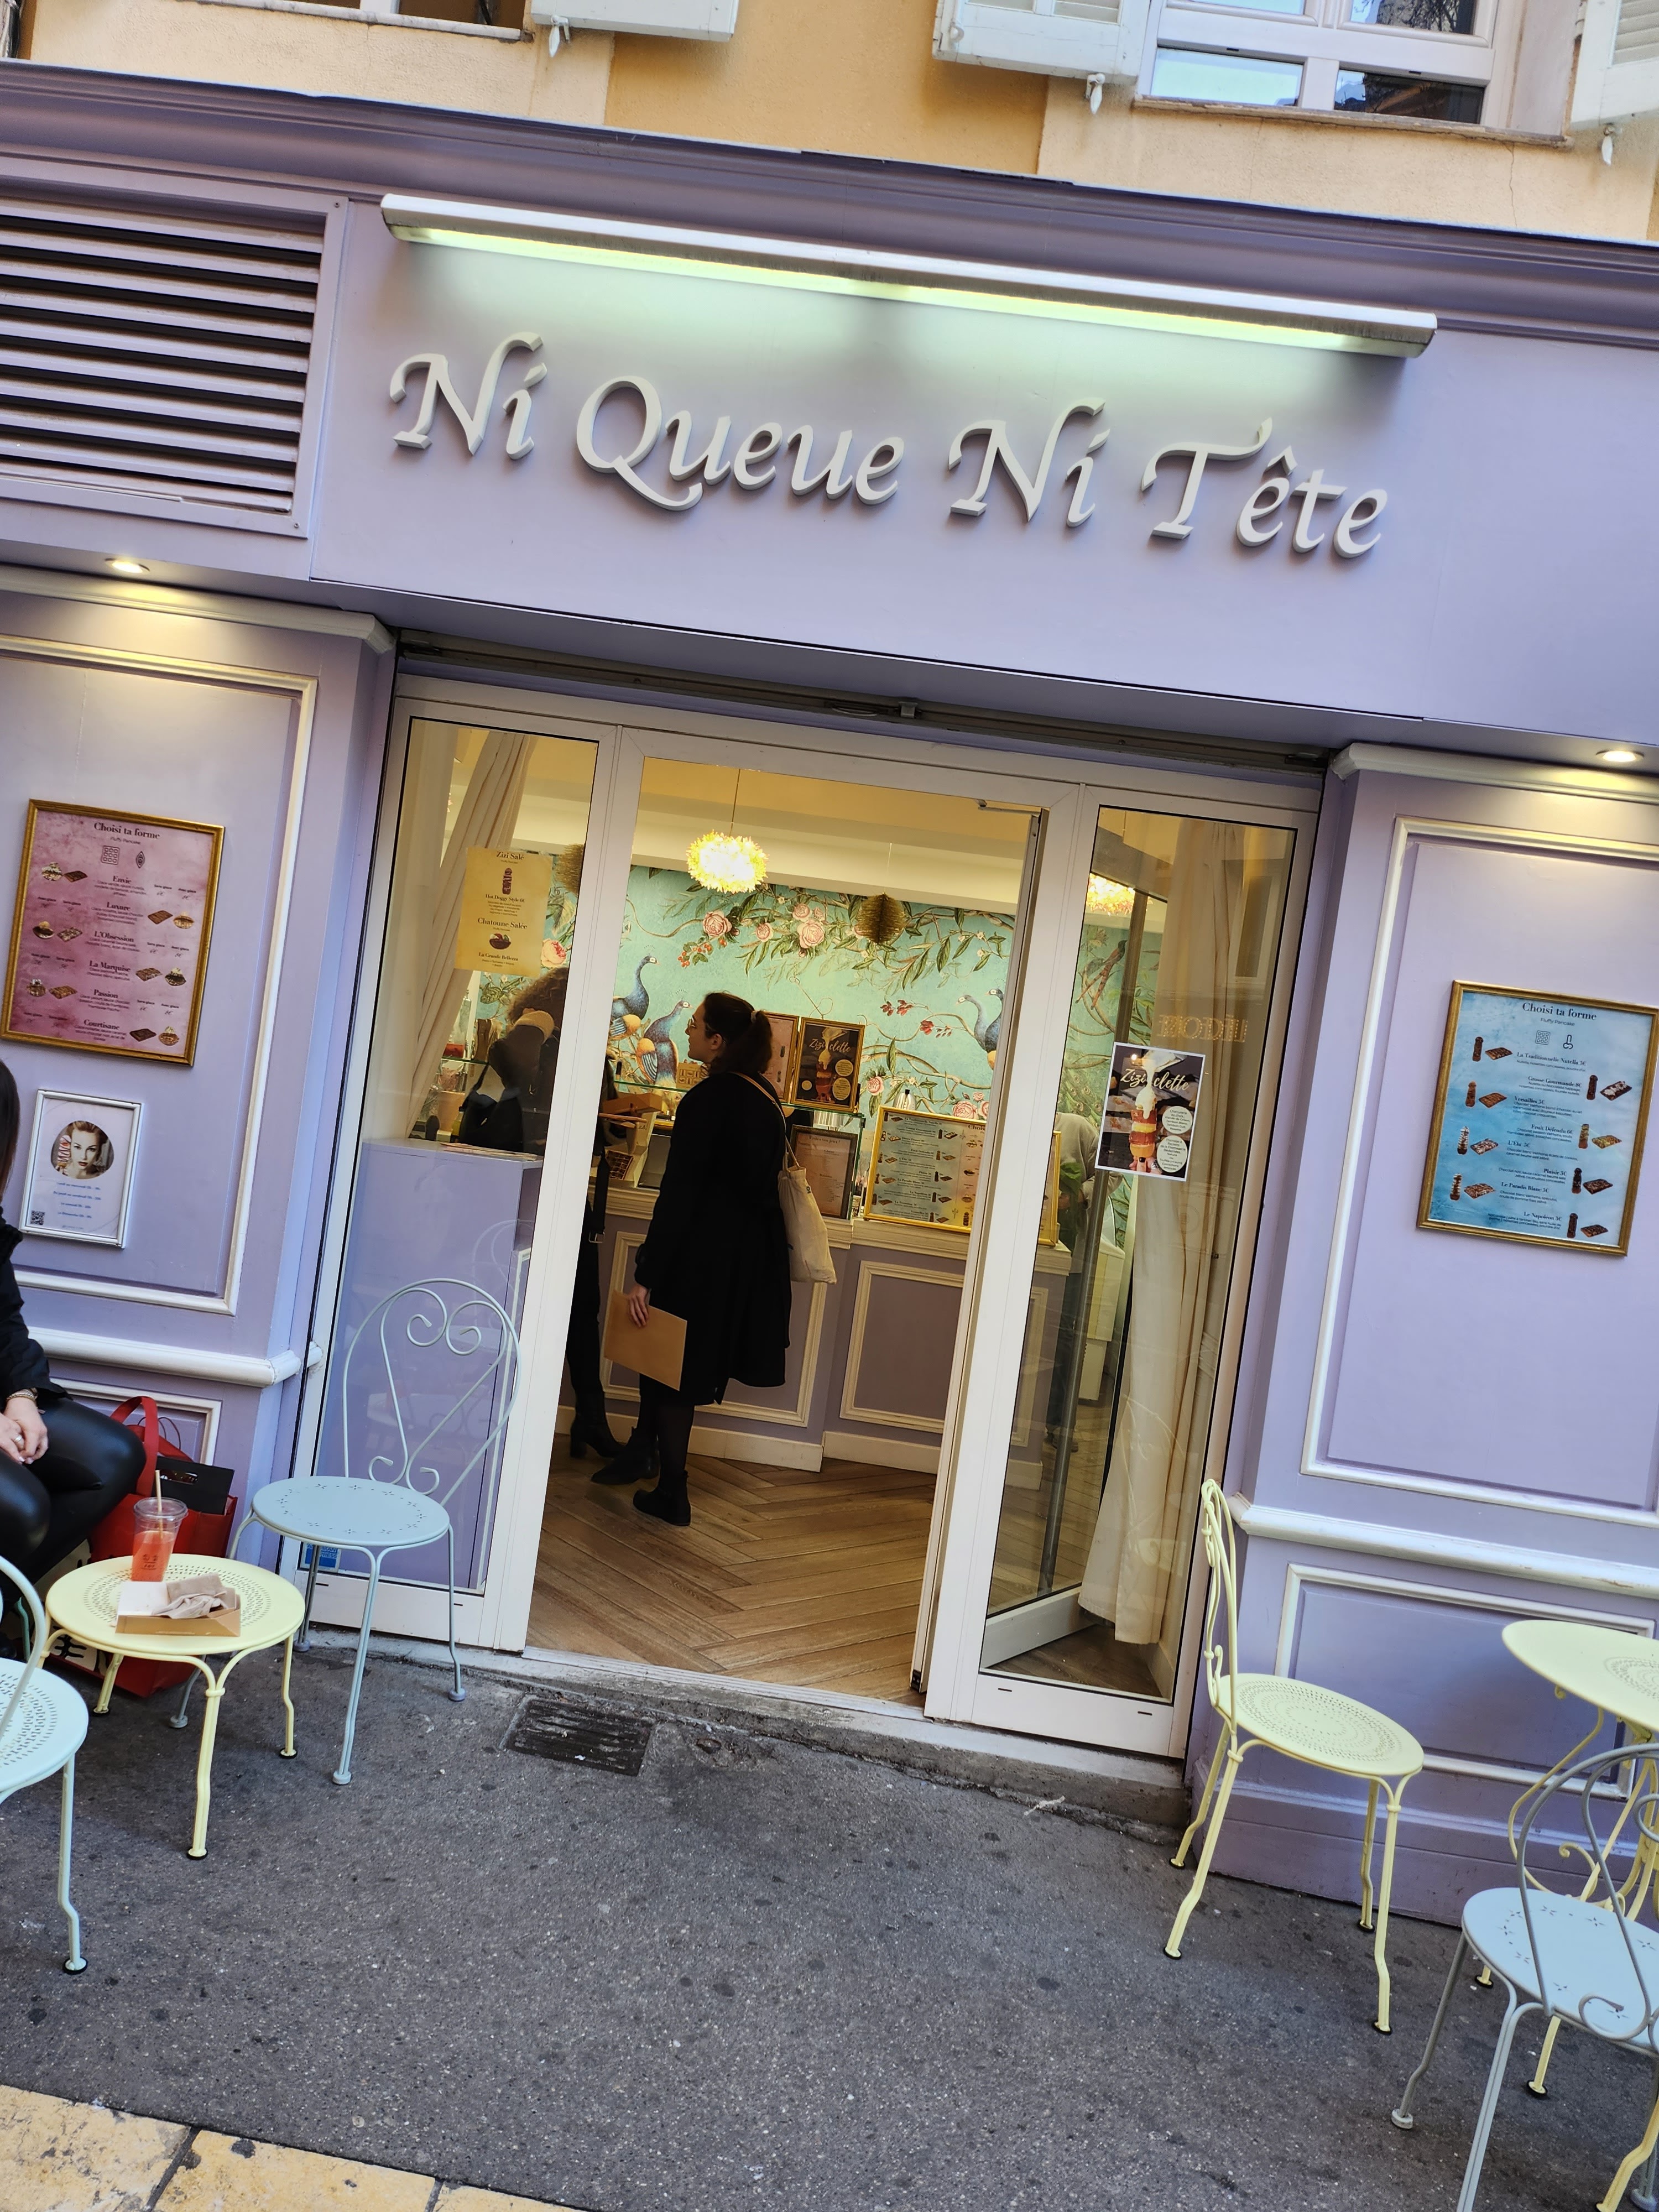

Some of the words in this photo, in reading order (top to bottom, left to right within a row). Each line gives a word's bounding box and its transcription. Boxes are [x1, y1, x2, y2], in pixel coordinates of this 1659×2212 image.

[390, 332, 547, 460] Ni
[576, 375, 904, 512] Queue
[948, 399, 1110, 528] Ni
[1141, 417, 1388, 559] Tête
[94, 822, 122, 833] Choisi
[133, 828, 159, 838] forme
[113, 875, 132, 884] Envie
[106, 902, 131, 910] Luxure
[478, 918, 508, 927] Chatoune
[94, 931, 134, 942] L'Obsession
[99, 962, 131, 972] Marquise
[94, 989, 118, 998] Passion
[1522, 1002, 1553, 1014] Choisi
[1568, 1009, 1597, 1020] forme
[84, 1019, 119, 1030] Courtisane
[809, 1039, 825, 1051] Zizi
[1524, 1053, 1559, 1062] Traditionnelle
[1120, 1068, 1146, 1087] Zizi
[1154, 1072, 1190, 1091] clette
